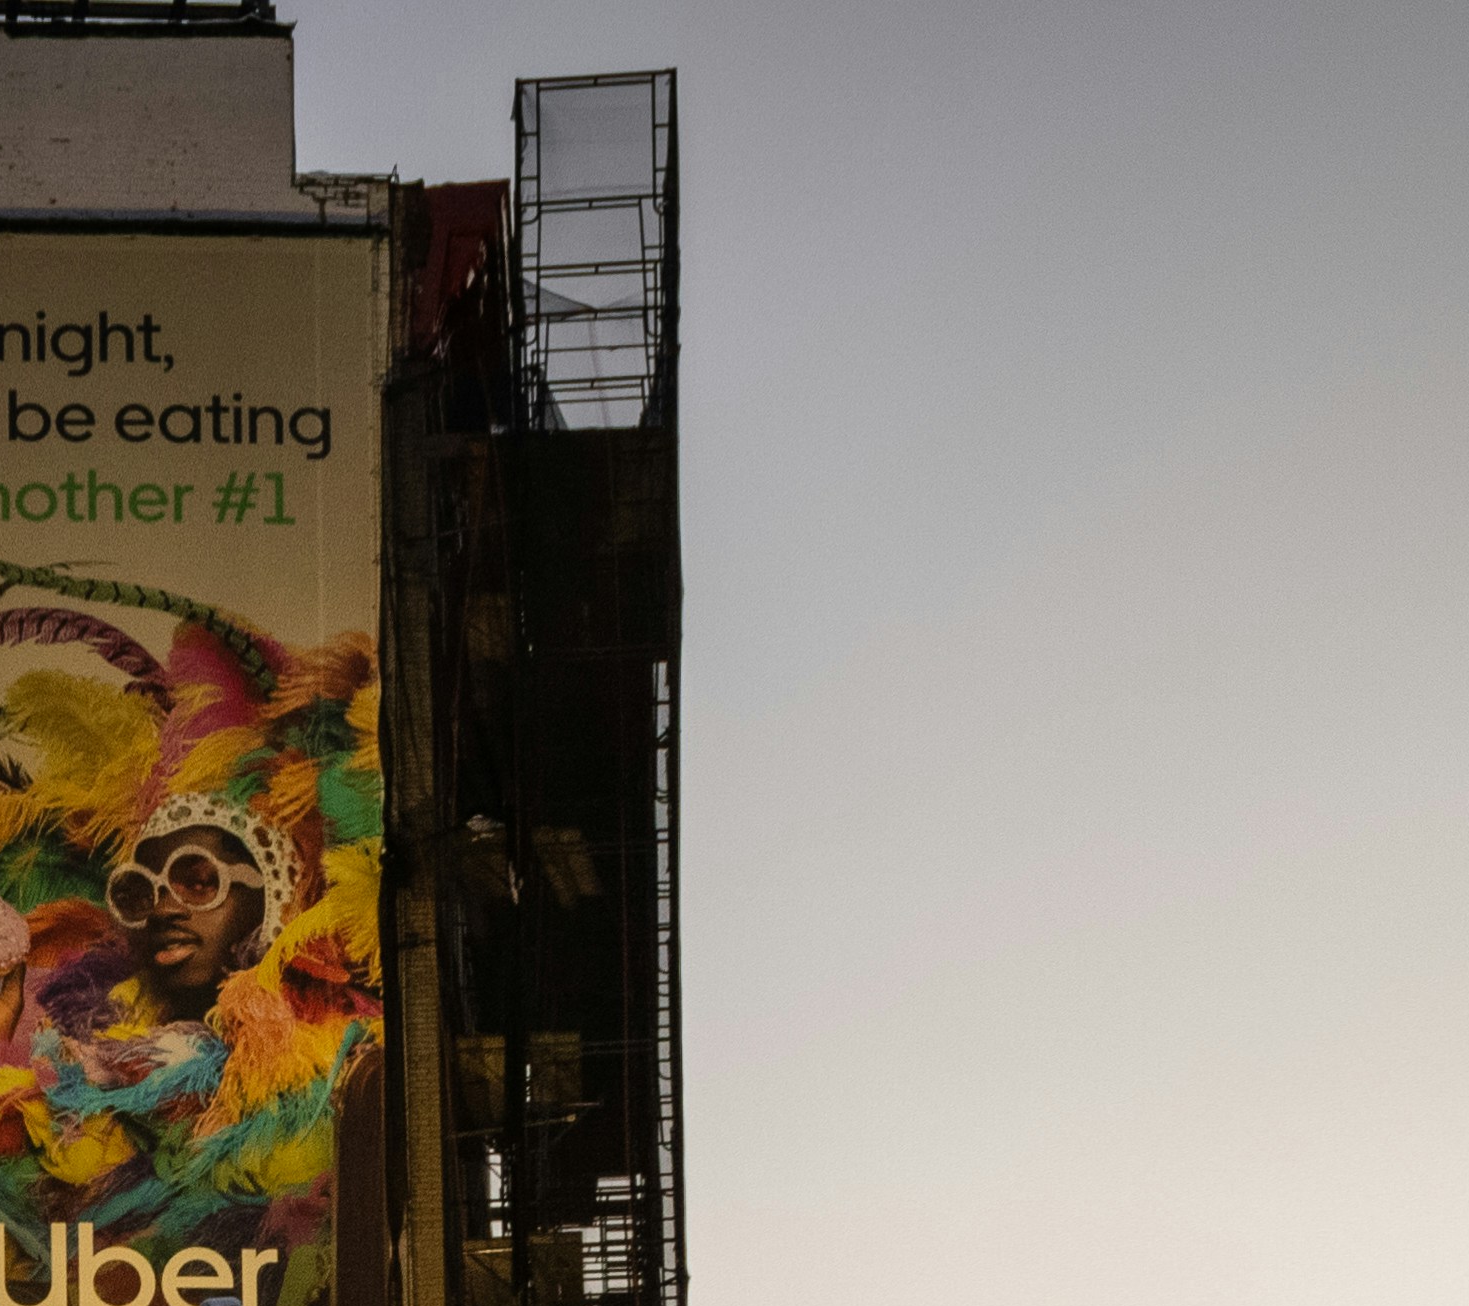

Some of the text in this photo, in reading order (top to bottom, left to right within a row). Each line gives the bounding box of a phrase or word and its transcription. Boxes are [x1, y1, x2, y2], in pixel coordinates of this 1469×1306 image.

[7, 388, 94, 444] be
[114, 392, 331, 459] eating
[213, 471, 297, 527] #1
